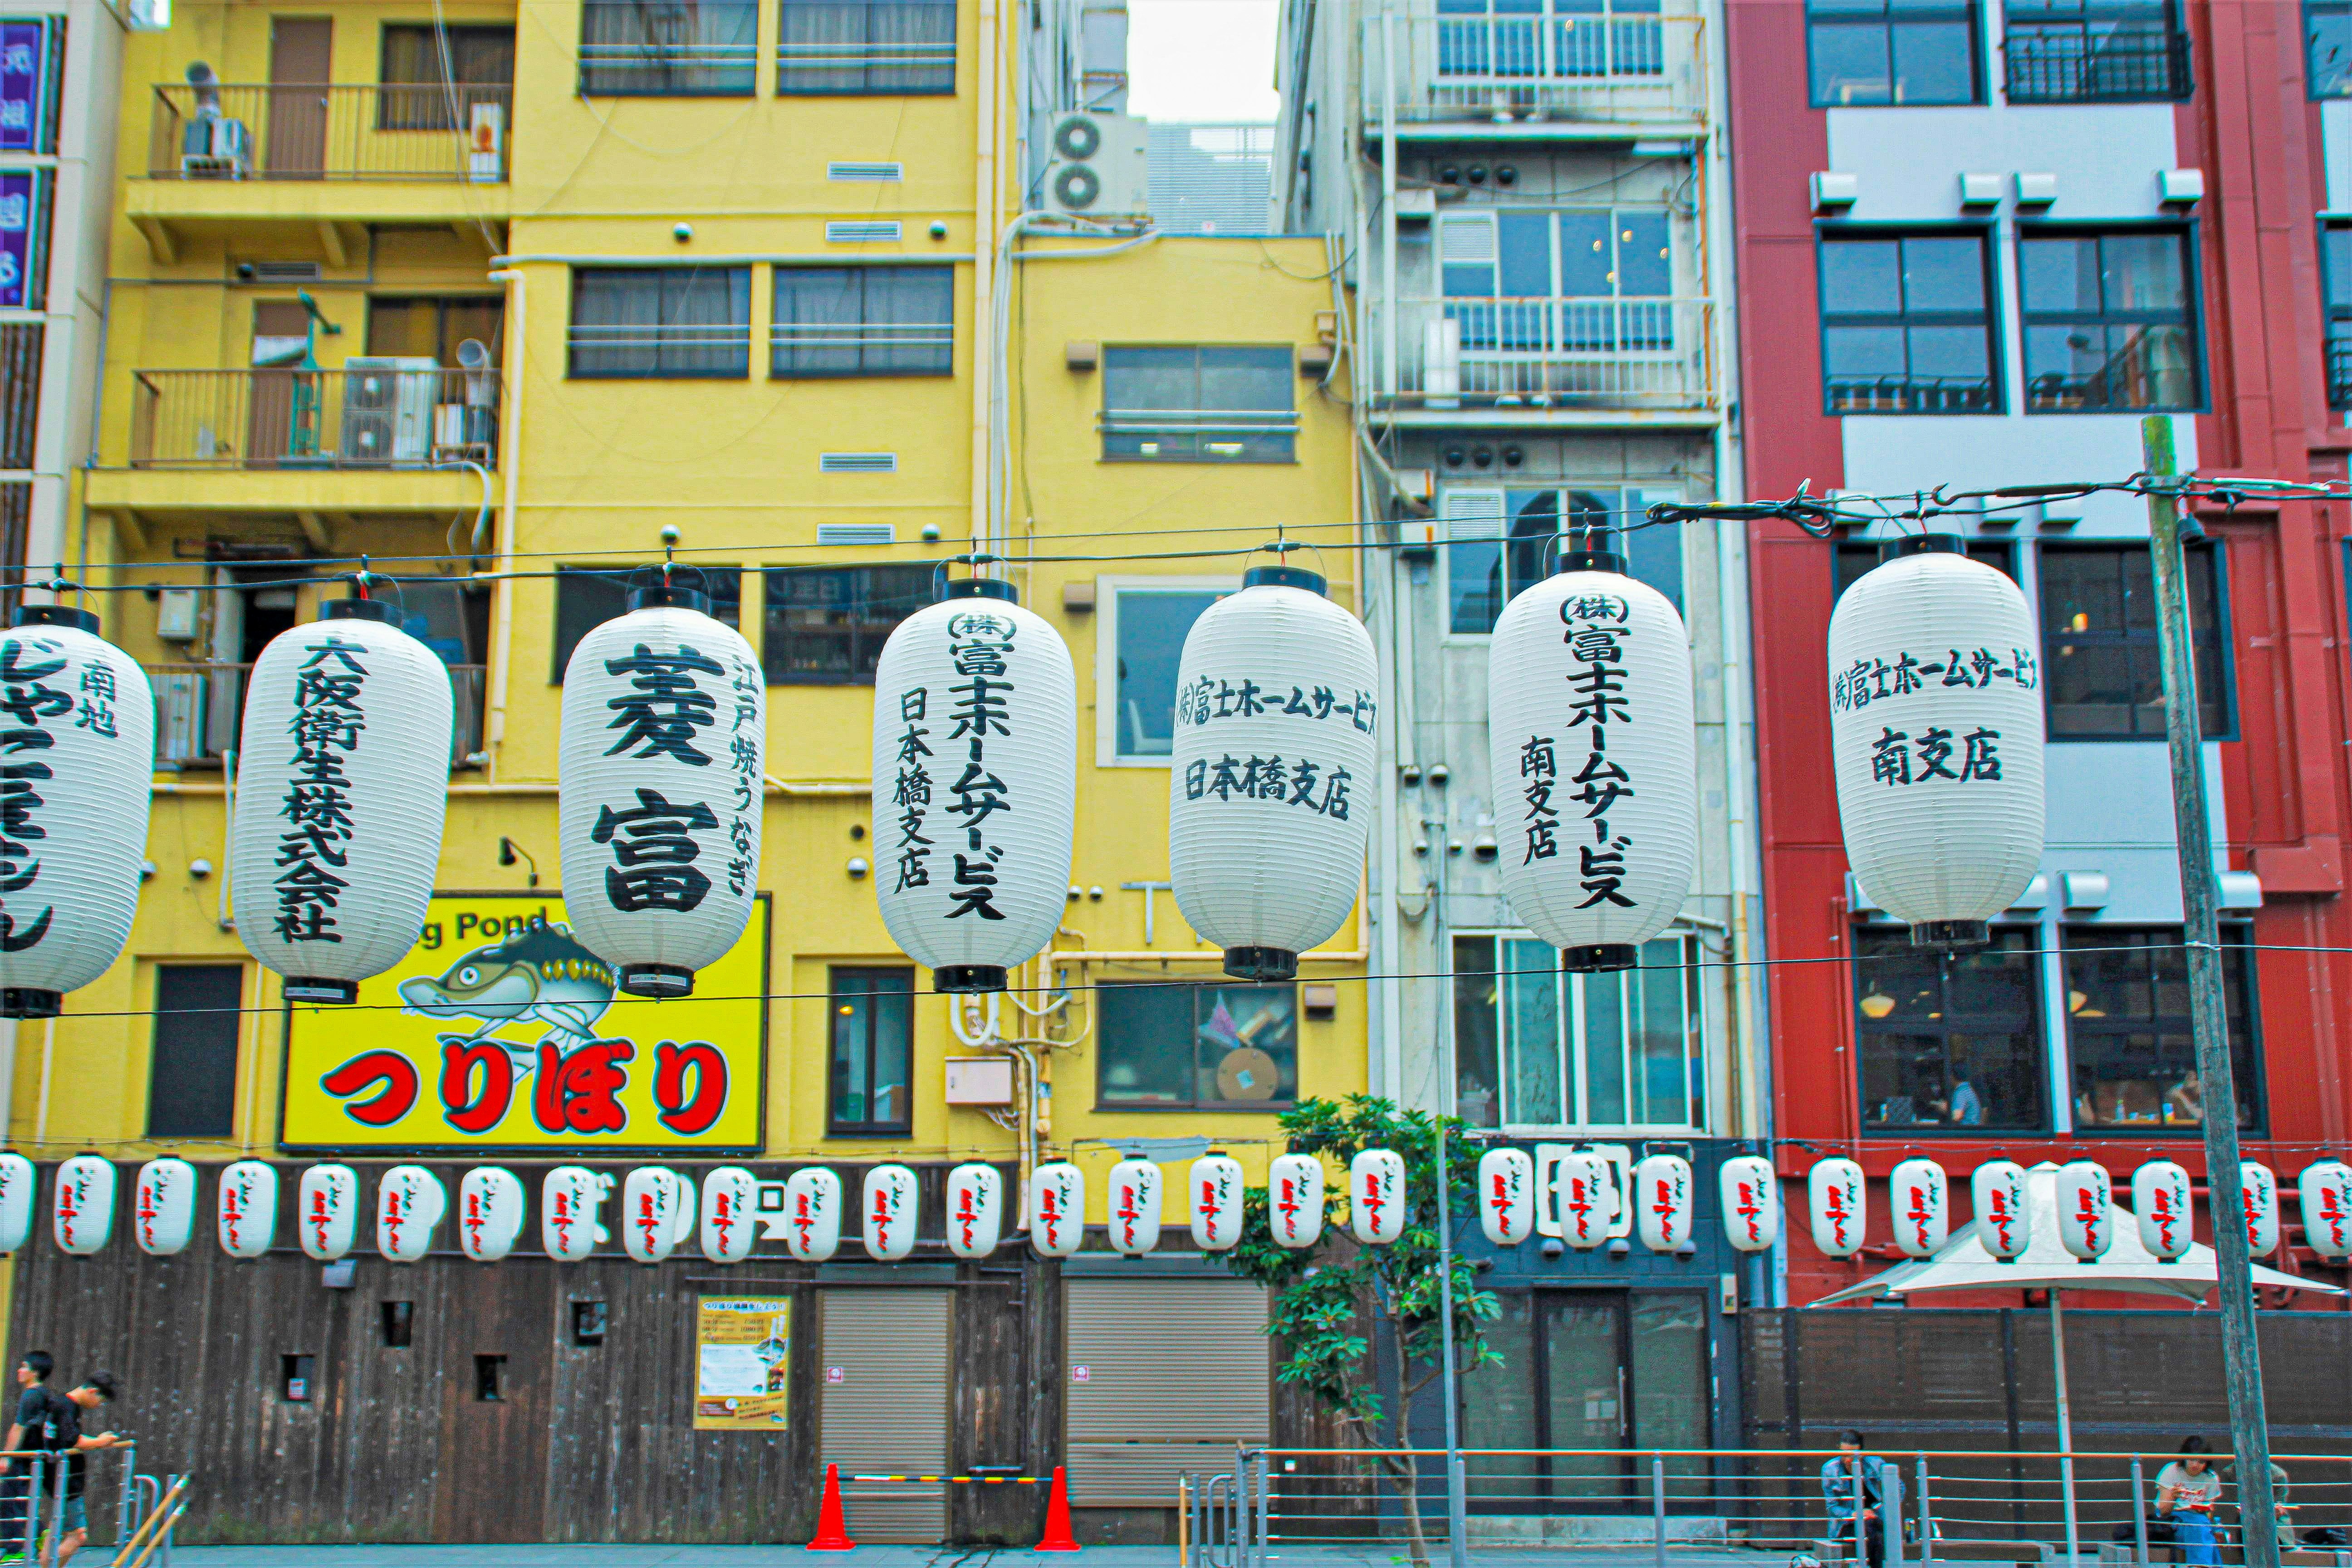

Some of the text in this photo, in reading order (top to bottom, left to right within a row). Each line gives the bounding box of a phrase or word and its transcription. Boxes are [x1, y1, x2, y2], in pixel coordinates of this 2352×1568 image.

[271, 636, 371, 944] 大阪衛生株式会社
[590, 643, 725, 912] 菱富
[892, 687, 935, 894] 日本橋支店
[1186, 754, 1352, 821] 日本橋支店
[1521, 735, 1560, 867] 南支店
[1871, 725, 2002, 786] 南支店
[456, 906, 547, 939] Pond
[320, 1035, 730, 1136] つりぼり
